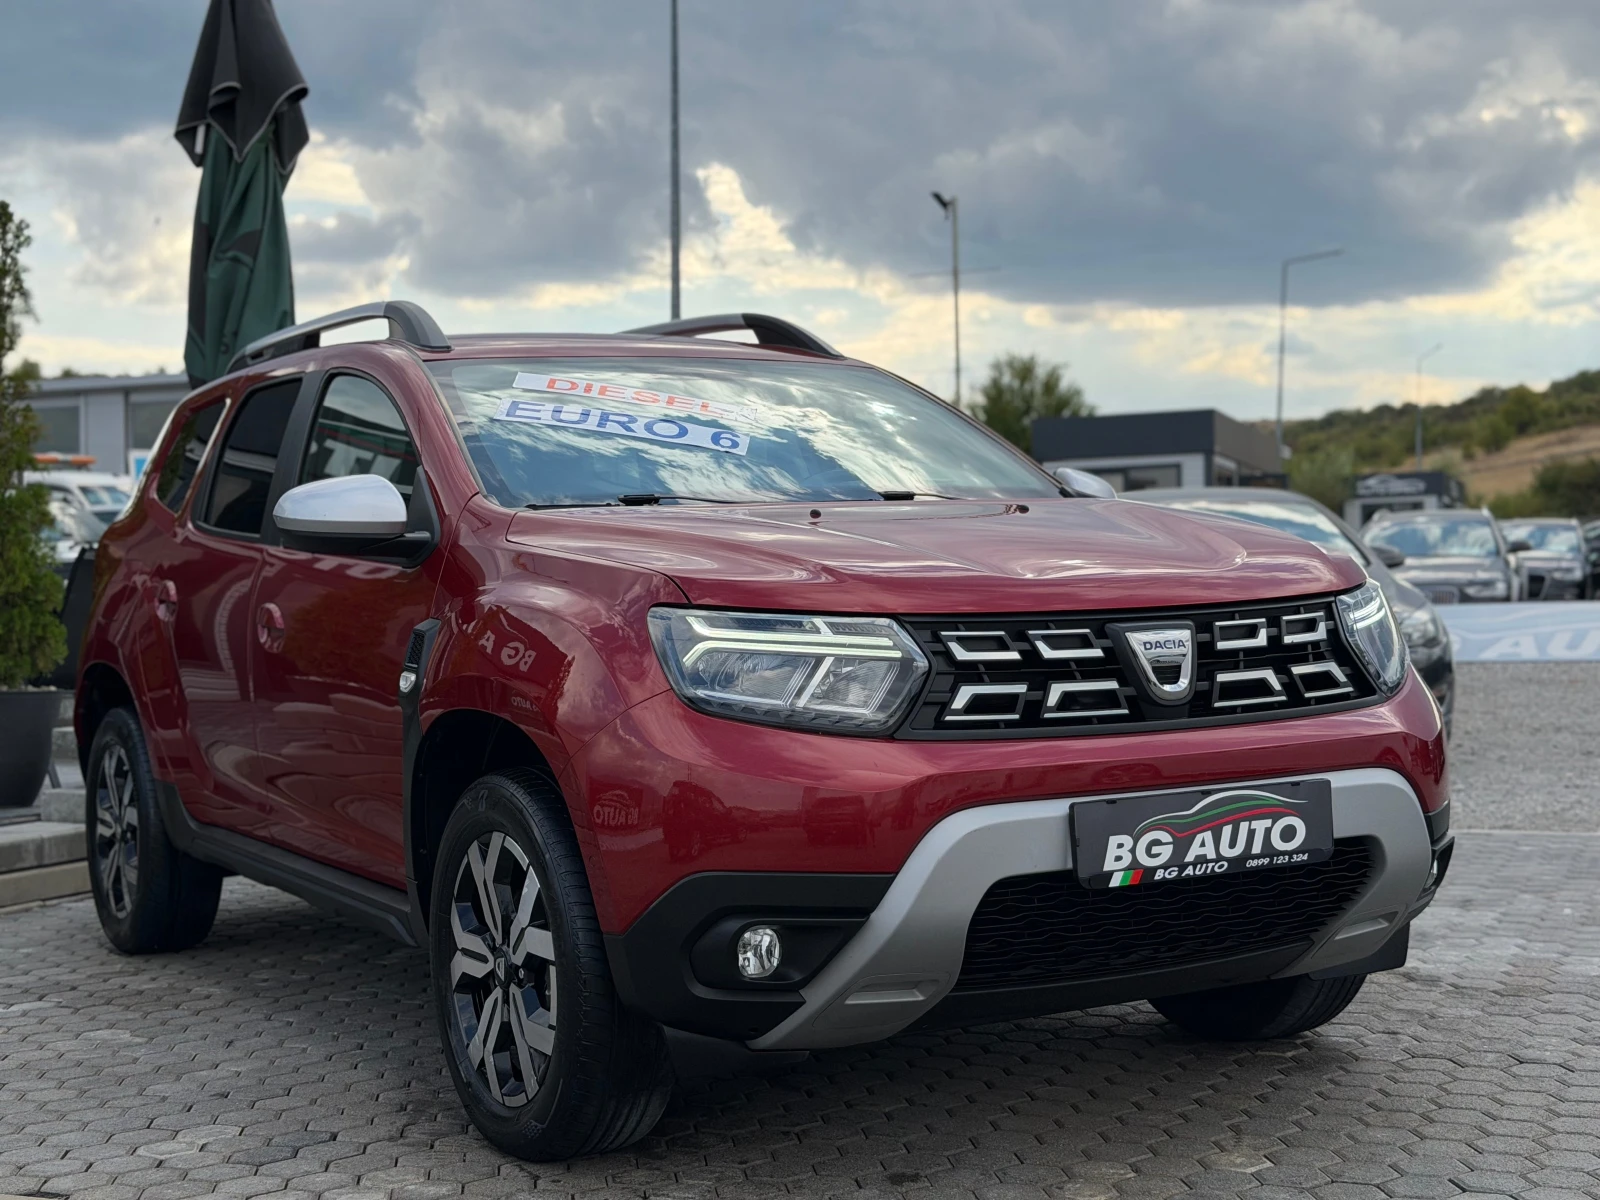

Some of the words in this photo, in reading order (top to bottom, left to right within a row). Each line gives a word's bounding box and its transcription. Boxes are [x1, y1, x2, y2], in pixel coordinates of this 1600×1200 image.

[546, 378, 732, 416] DIESEL
[505, 400, 689, 439] EURO
[710, 430, 741, 450] 6
[1143, 639, 1187, 651] DACIA
[1103, 830, 1174, 872] BG
[1184, 816, 1306, 863] AUTO
[1154, 866, 1178, 881] BG
[1181, 861, 1228, 877] AUTO
[1246, 857, 1270, 869] 0899
[1272, 855, 1289, 865] 123
[1291, 853, 1309, 863] 324
